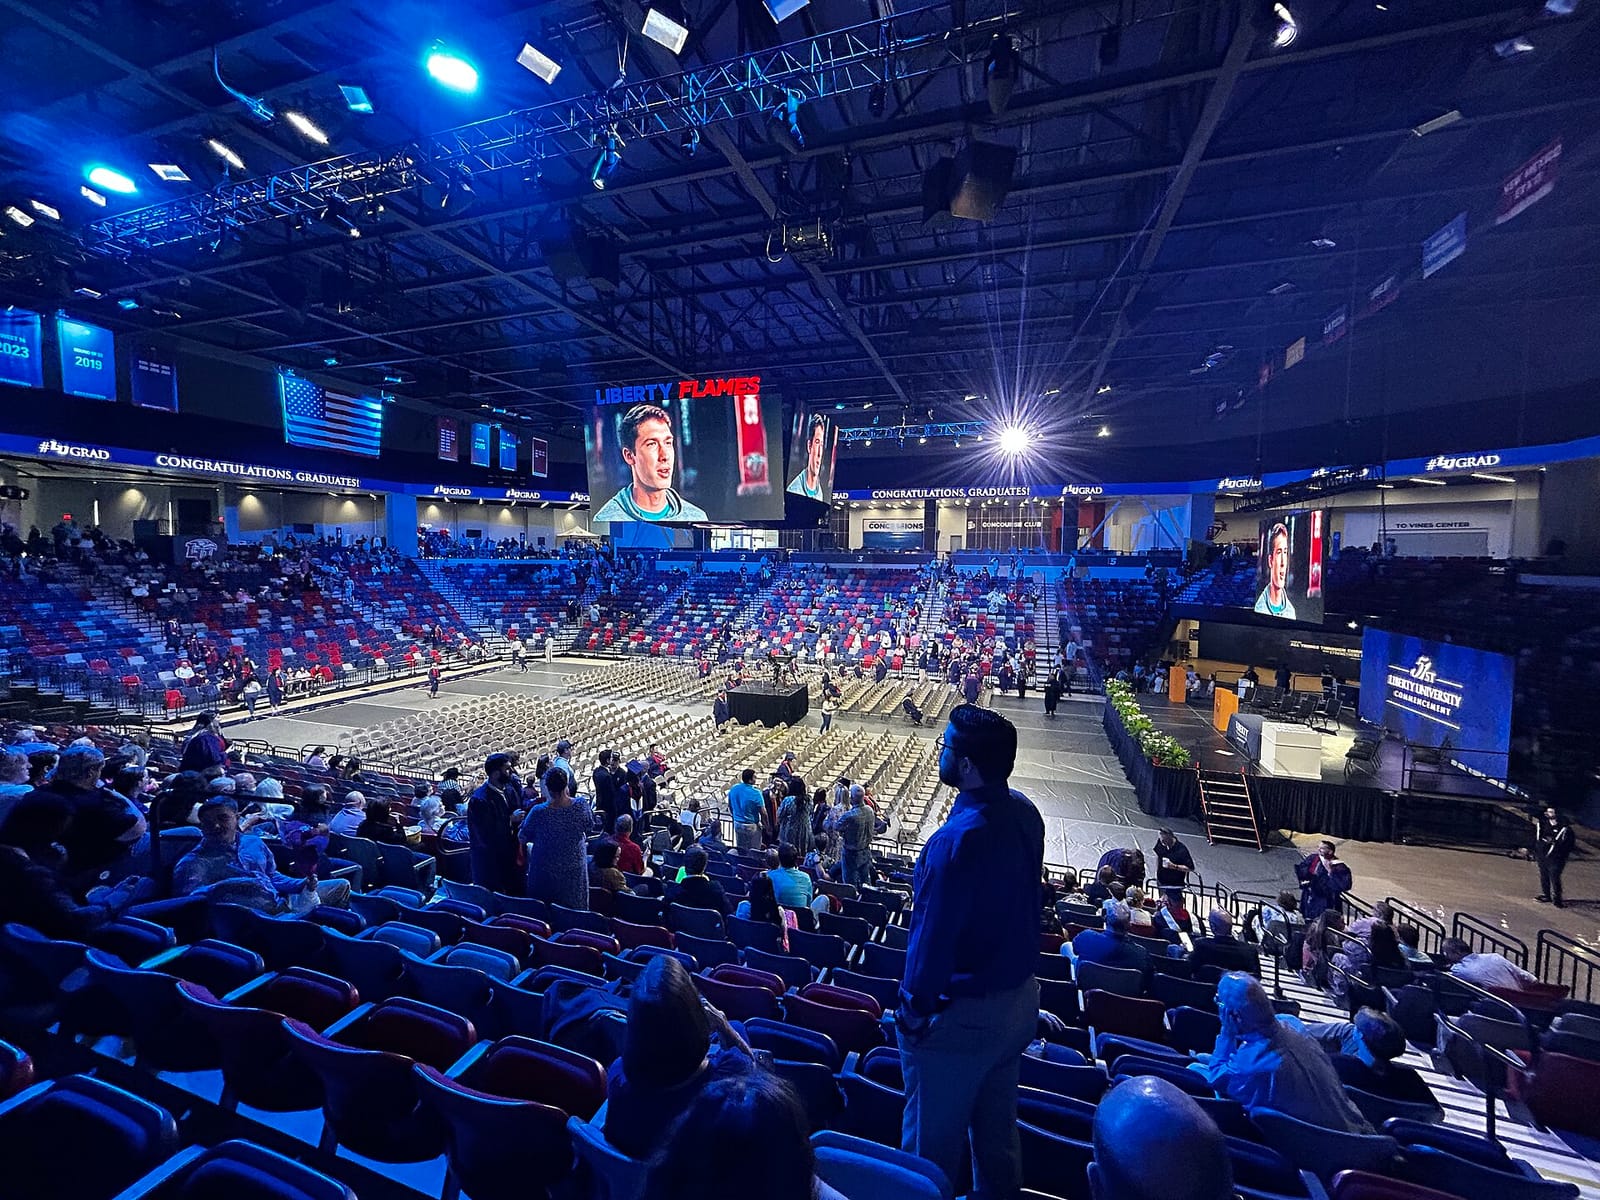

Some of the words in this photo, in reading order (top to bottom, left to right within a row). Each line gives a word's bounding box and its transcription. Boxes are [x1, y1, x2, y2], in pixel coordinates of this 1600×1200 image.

[75, 356, 103, 370] 2019
[596, 382, 672, 405] LIBERTY
[679, 376, 761, 399] FLAMES
[39, 439, 110, 460] #LUGRAD
[156, 455, 294, 481] CONGRATULATIONS,
[296, 472, 360, 488] GRADUATES!
[1425, 454, 1500, 472] #LUGRAD
[872, 487, 966, 500] CONGRATULATIONS,
[968, 485, 1031, 498] GRADUATES!
[868, 522, 924, 530] CONCIONS
[1387, 674, 1416, 693] LIBERTY
[1415, 683, 1462, 708] UNIVERSITY
[1393, 690, 1451, 716] COMMENCEMENT
